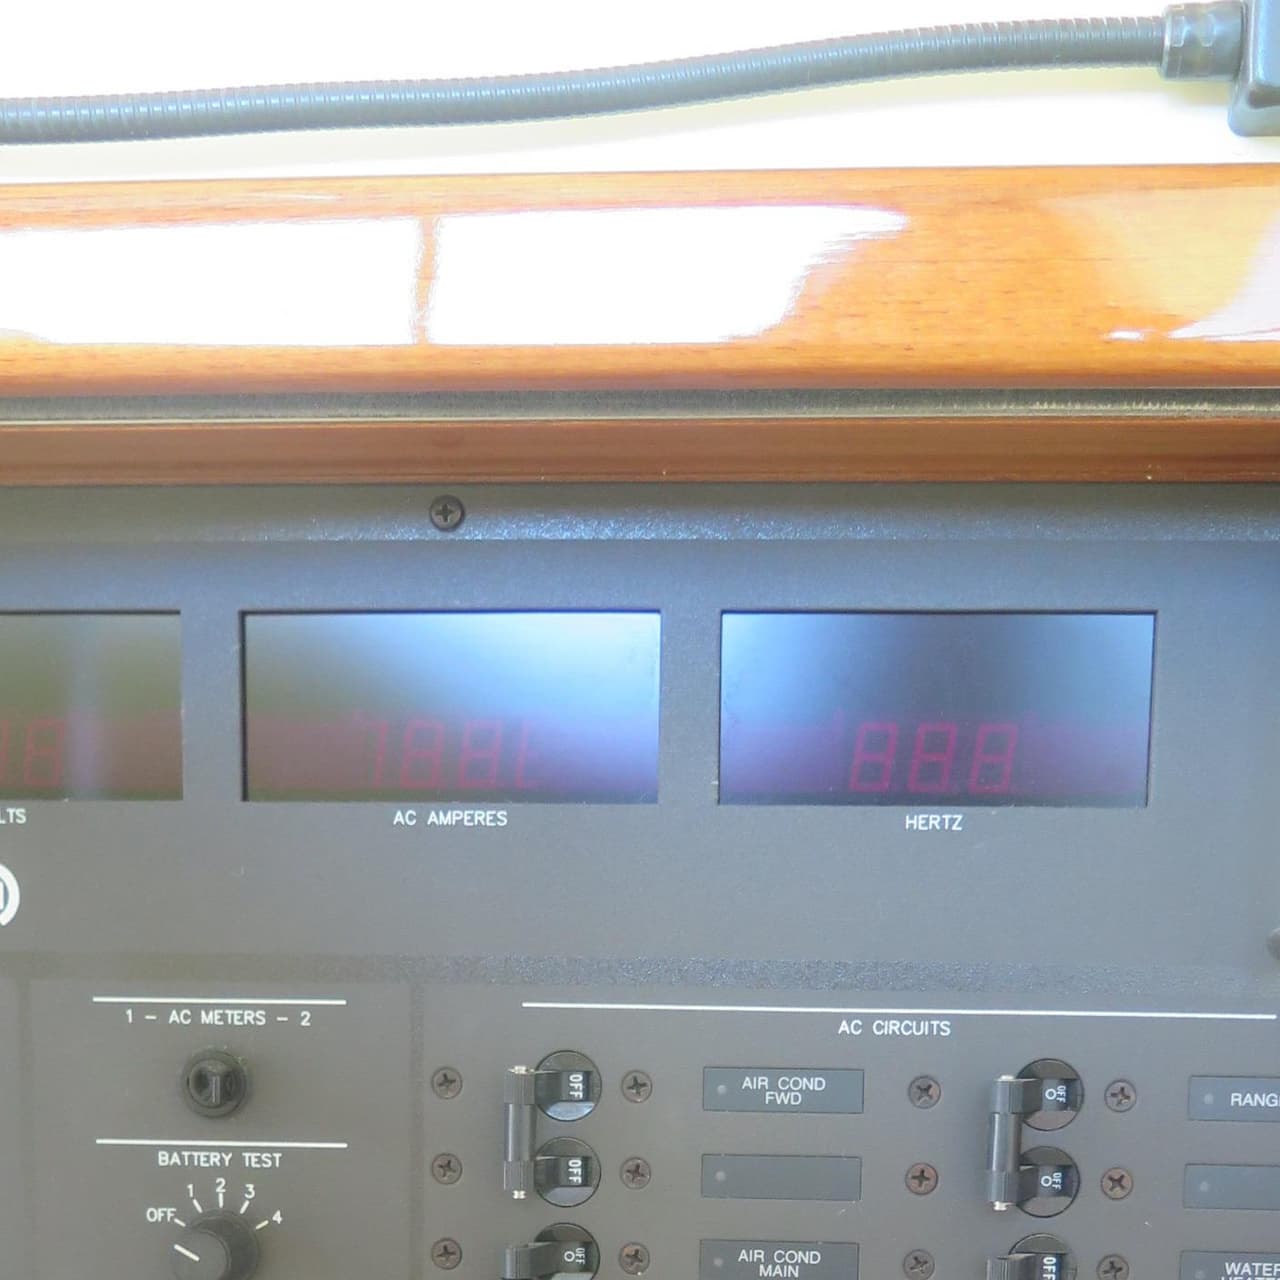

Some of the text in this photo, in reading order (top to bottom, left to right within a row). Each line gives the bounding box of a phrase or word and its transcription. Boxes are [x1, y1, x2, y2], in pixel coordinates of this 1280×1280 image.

[394, 810, 508, 826] AC AMPERES
[906, 814, 962, 830] HERTZ
[126, 1008, 132, 1022] 1
[168, 1010, 192, 1024] AC
[200, 1010, 266, 1026] METERS
[300, 1010, 310, 1026] 2
[838, 1020, 950, 1036] AC CIRCUITS
[570, 1074, 584, 1098] OFF
[742, 1076, 826, 1090] AIR COND
[766, 1092, 802, 1104] FWD
[1056, 1086, 1066, 1102] OFF
[158, 1150, 282, 1168] BATTERY TEST
[568, 1160, 582, 1184] OFF
[216, 1178, 226, 1193] 2
[1052, 1172, 1062, 1190] OFF
[188, 1184, 194, 1198] 1
[244, 1184, 256, 1198] 3
[146, 1208, 176, 1222] OFF
[272, 1210, 282, 1224] 4
[575, 1248, 586, 1264] OFF
[738, 1250, 820, 1264] AIR COND
[760, 1264, 798, 1278] MAIN
[1042, 1256, 1056, 1280] OFF
